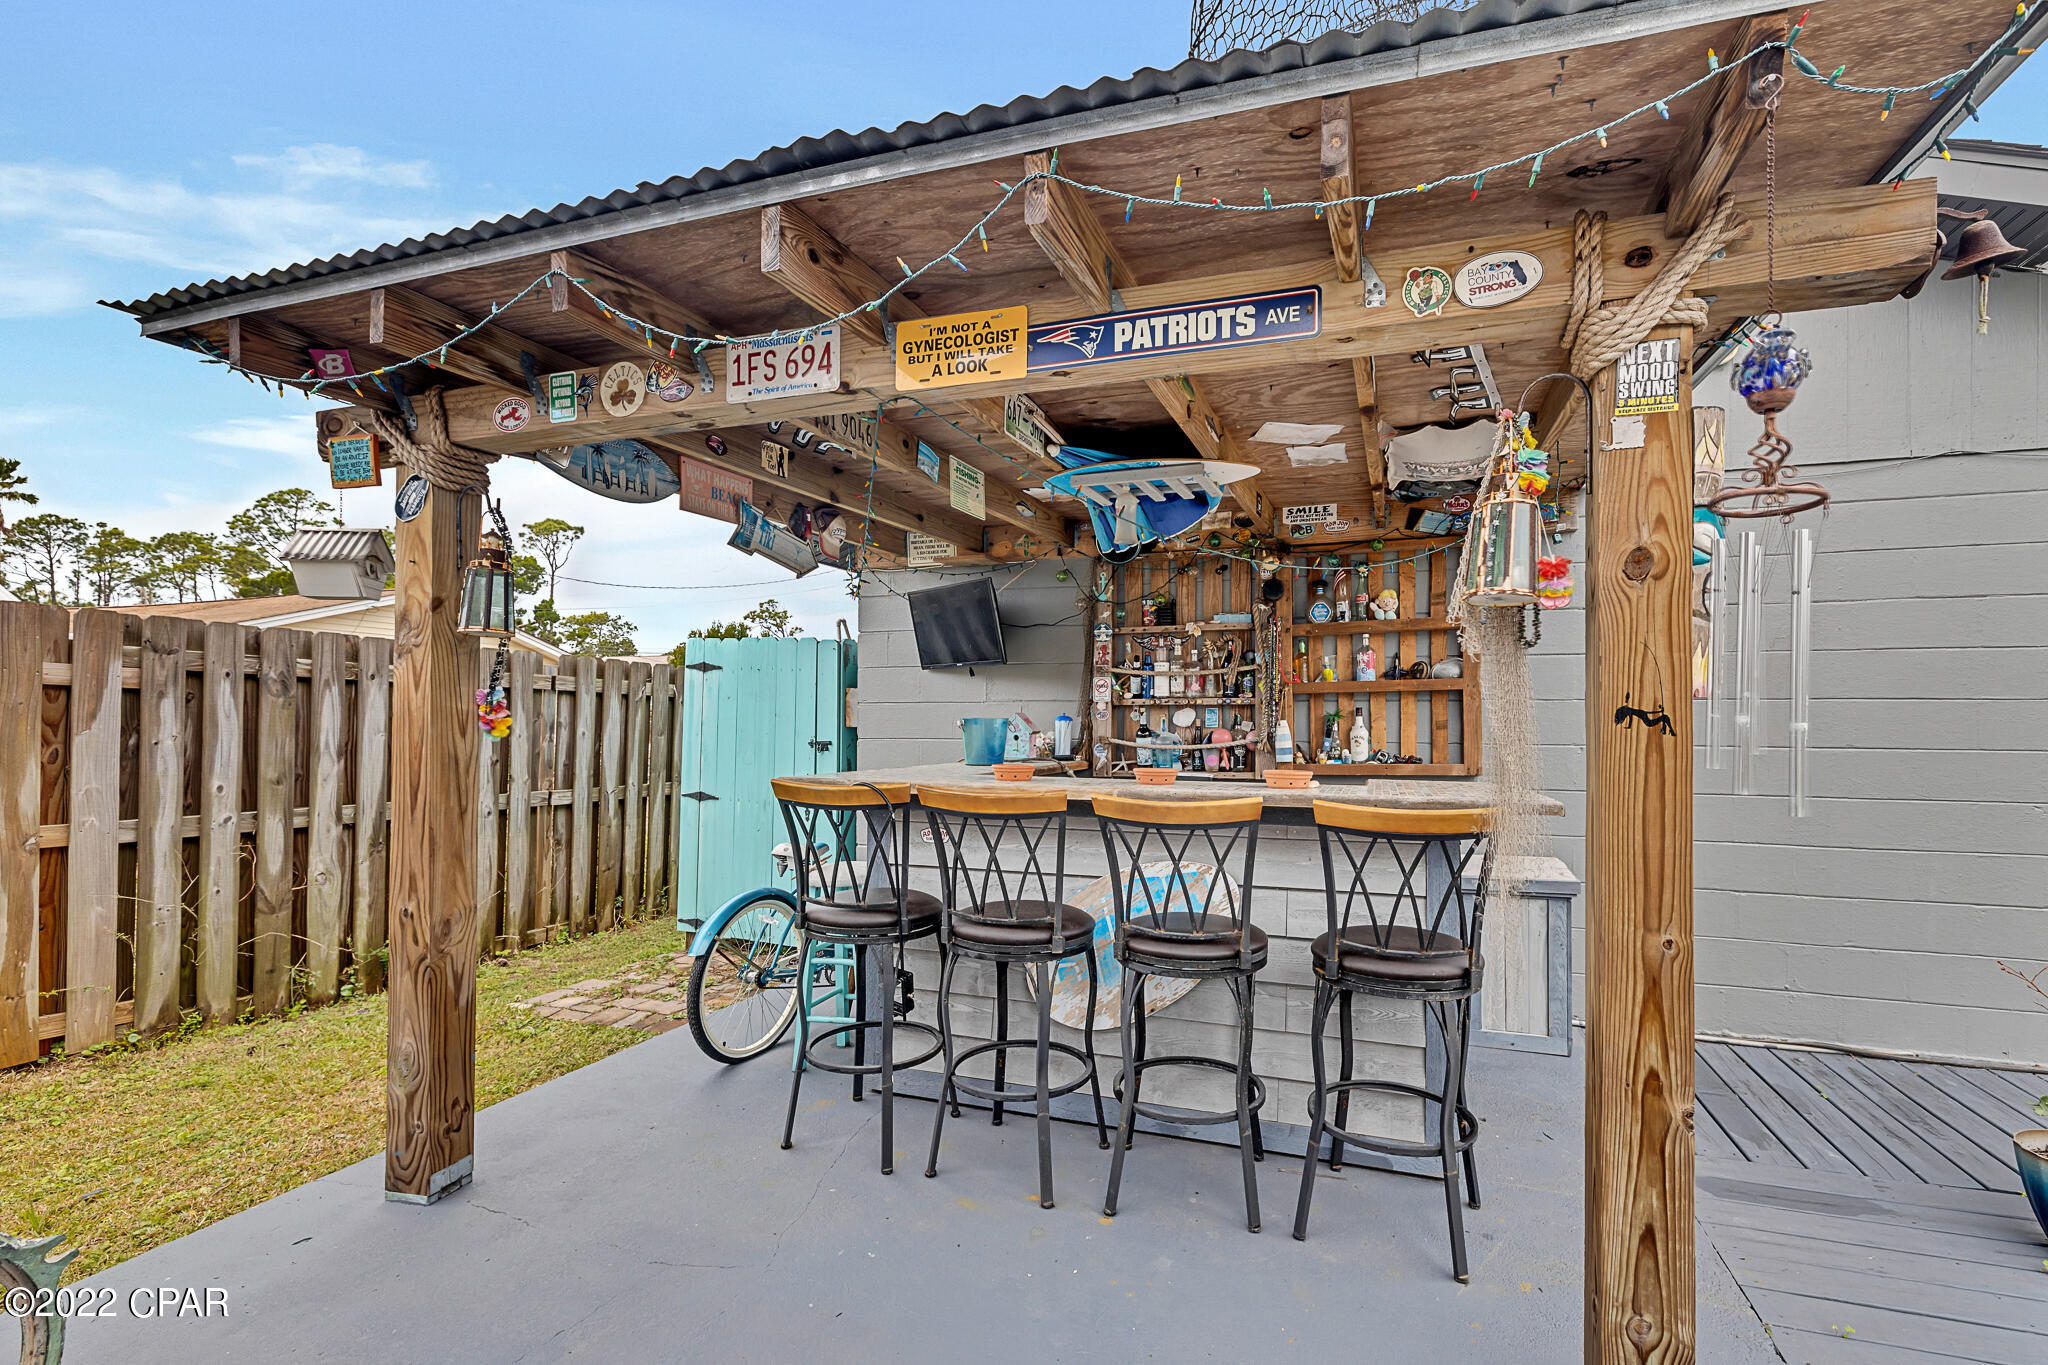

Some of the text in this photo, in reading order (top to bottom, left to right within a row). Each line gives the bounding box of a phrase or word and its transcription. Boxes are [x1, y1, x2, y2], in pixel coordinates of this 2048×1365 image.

[1468, 266, 1487, 278] BAY
[1468, 270, 1512, 286] COUNTY
[1469, 280, 1517, 296] STRONG
[929, 321, 991, 337] I'M NOT A
[1114, 305, 1301, 352] PATRIOTS AVE
[903, 328, 1019, 354] GYNECOLOGIST
[908, 354, 933, 364] BUT
[945, 349, 974, 360] WILL
[978, 344, 1013, 356] TAKE
[1620, 340, 1676, 365] NEXT
[732, 341, 832, 387] 1FS 694
[932, 359, 987, 377] A LOOK
[1620, 361, 1675, 383] MOOD
[605, 364, 643, 390] CELTICS
[765, 386, 780, 394] Spirit
[781, 384, 788, 392] of
[789, 383, 813, 391] America
[1618, 380, 1675, 398] SWING
[1628, 396, 1674, 406] MINUTES
[687, 463, 711, 483] WHAT
[1287, 505, 1330, 515] SMILE
[1291, 526, 1313, 537] PCB
